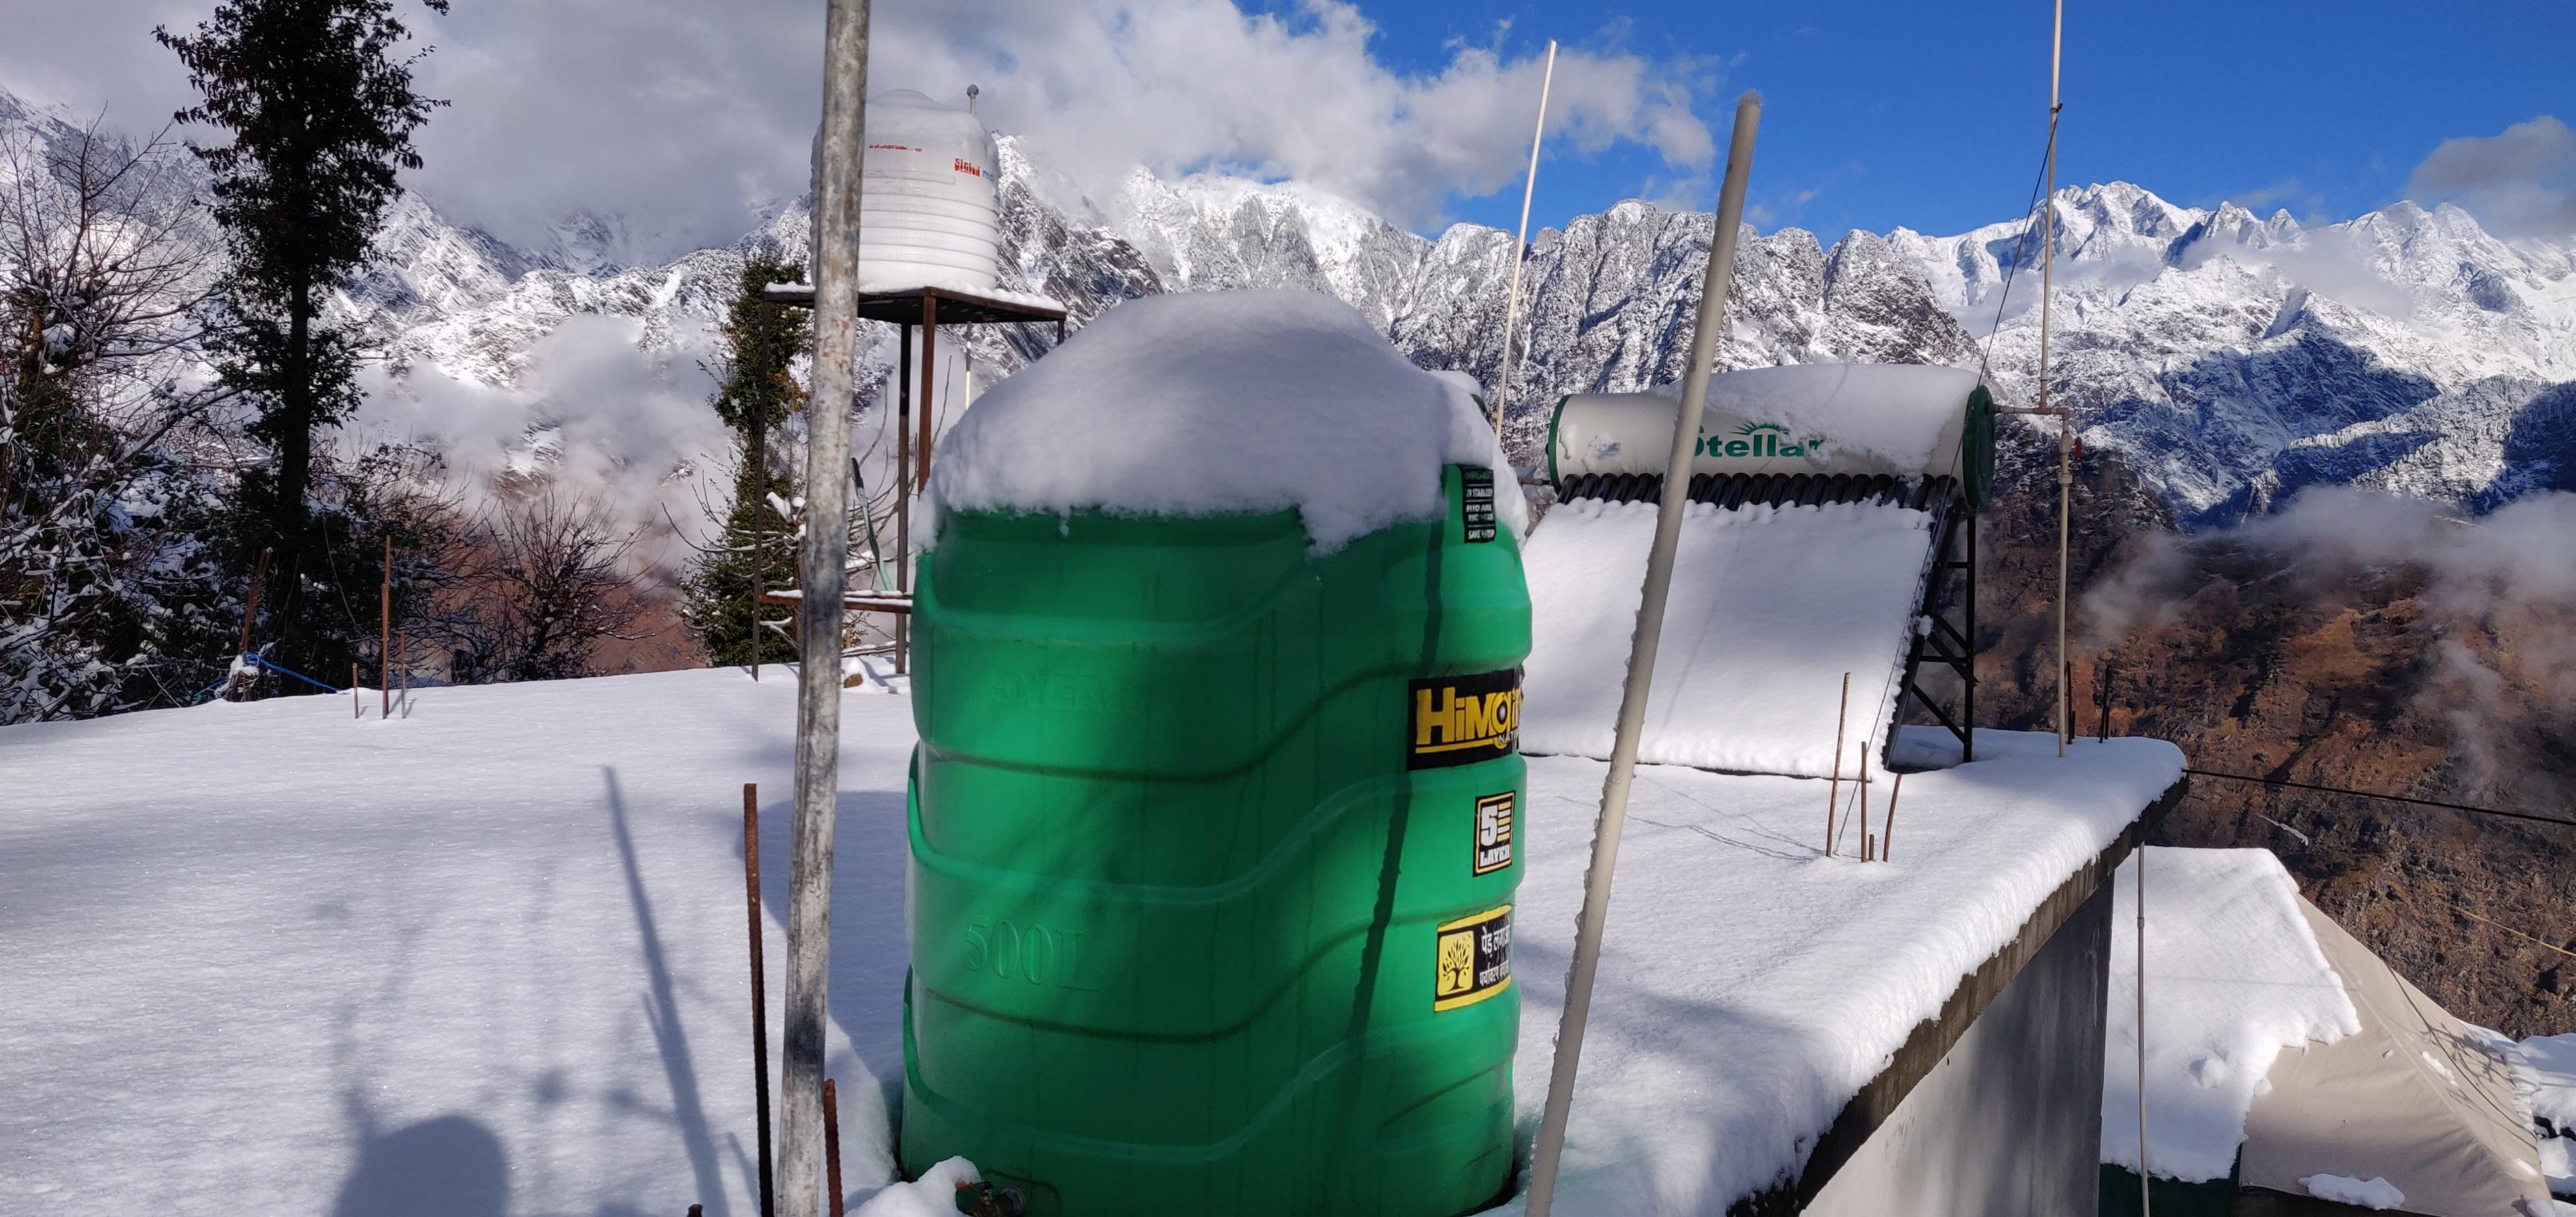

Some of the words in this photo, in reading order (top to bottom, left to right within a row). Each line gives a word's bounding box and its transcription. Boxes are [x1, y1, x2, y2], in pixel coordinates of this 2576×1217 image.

[1481, 805, 1498, 846] 5
[1479, 844, 1510, 867] LAYER
[963, 914, 1099, 992] 500L
